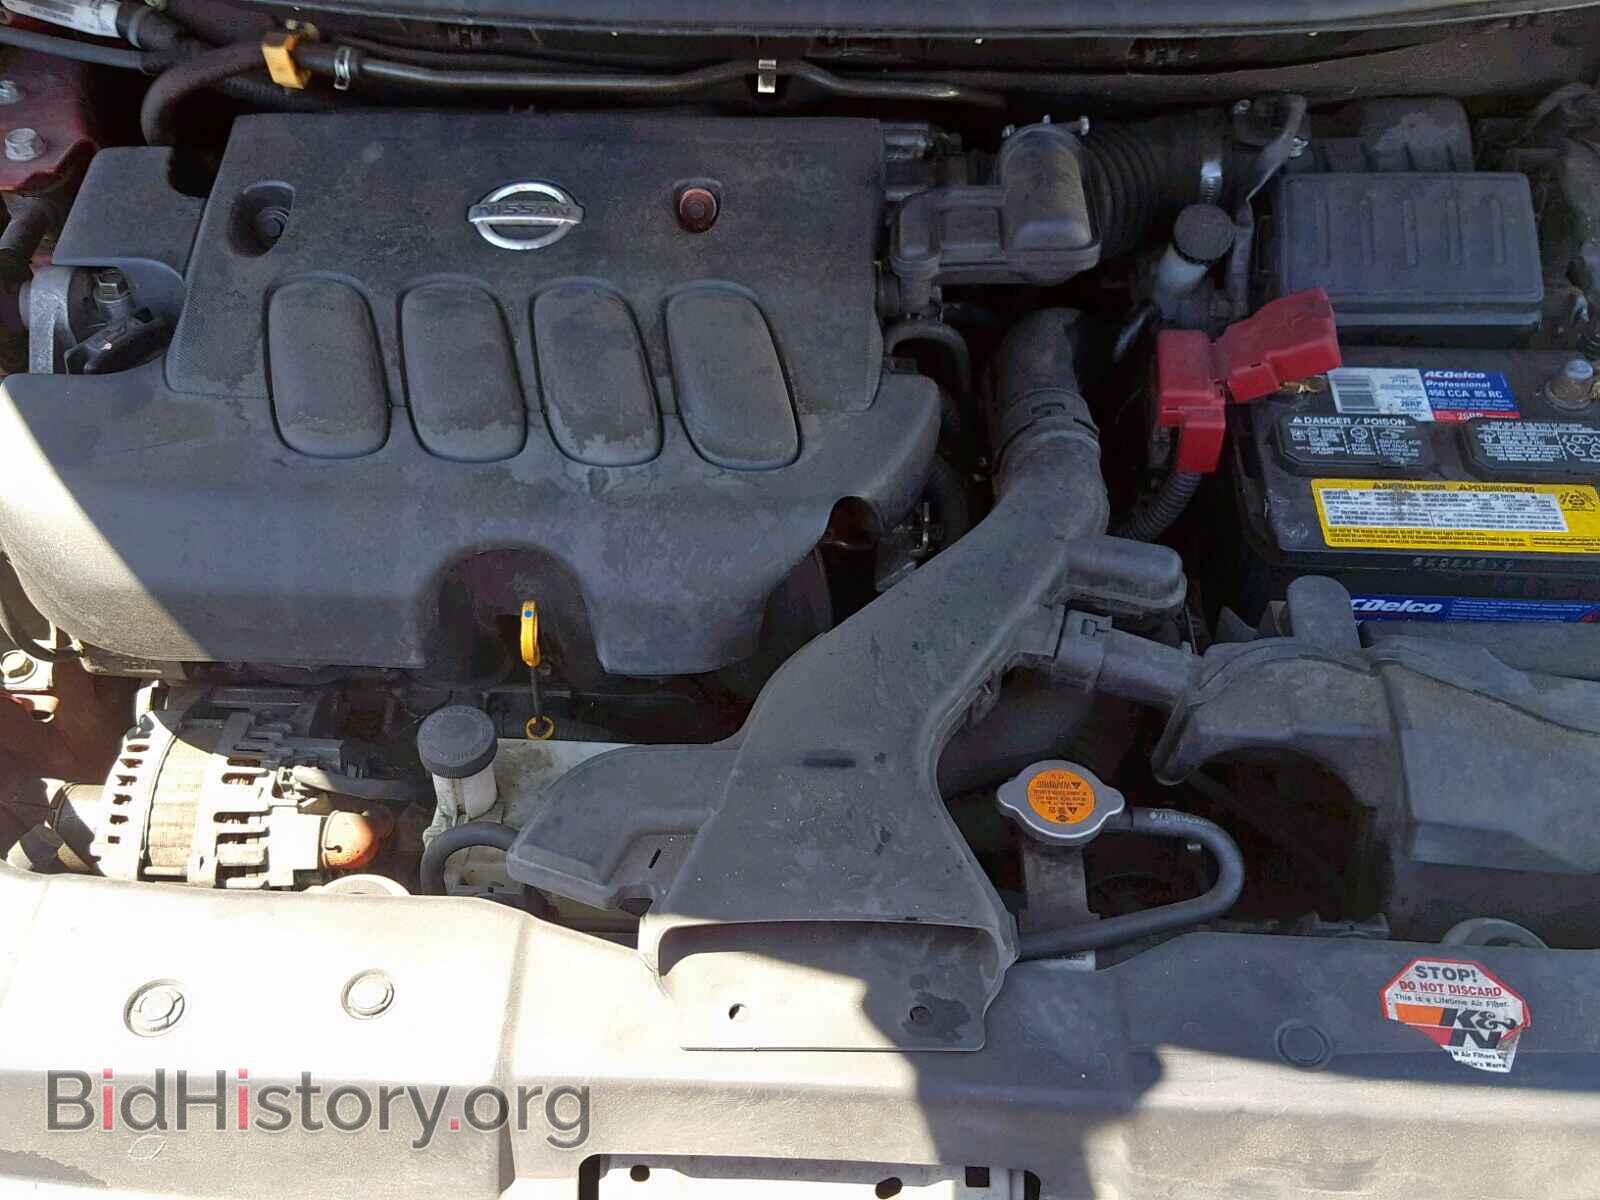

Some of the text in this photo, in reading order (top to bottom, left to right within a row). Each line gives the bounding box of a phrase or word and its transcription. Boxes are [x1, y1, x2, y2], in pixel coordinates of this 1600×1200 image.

[479, 205, 571, 216] NISSAN
[1424, 371, 1487, 379] ACDelco
[1425, 380, 1491, 389] Professional
[1447, 390, 1471, 398] CCA
[1488, 391, 1504, 399] RC
[1304, 416, 1351, 425] DANGER
[1363, 418, 1406, 426] POISON
[1414, 965, 1478, 983] STOP!
[1399, 981, 1502, 997] DO NOT DISCARD
[1393, 993, 1412, 1001] This
[1435, 996, 1468, 1006] Lifetime
[1473, 1052, 1496, 1060] Filters
